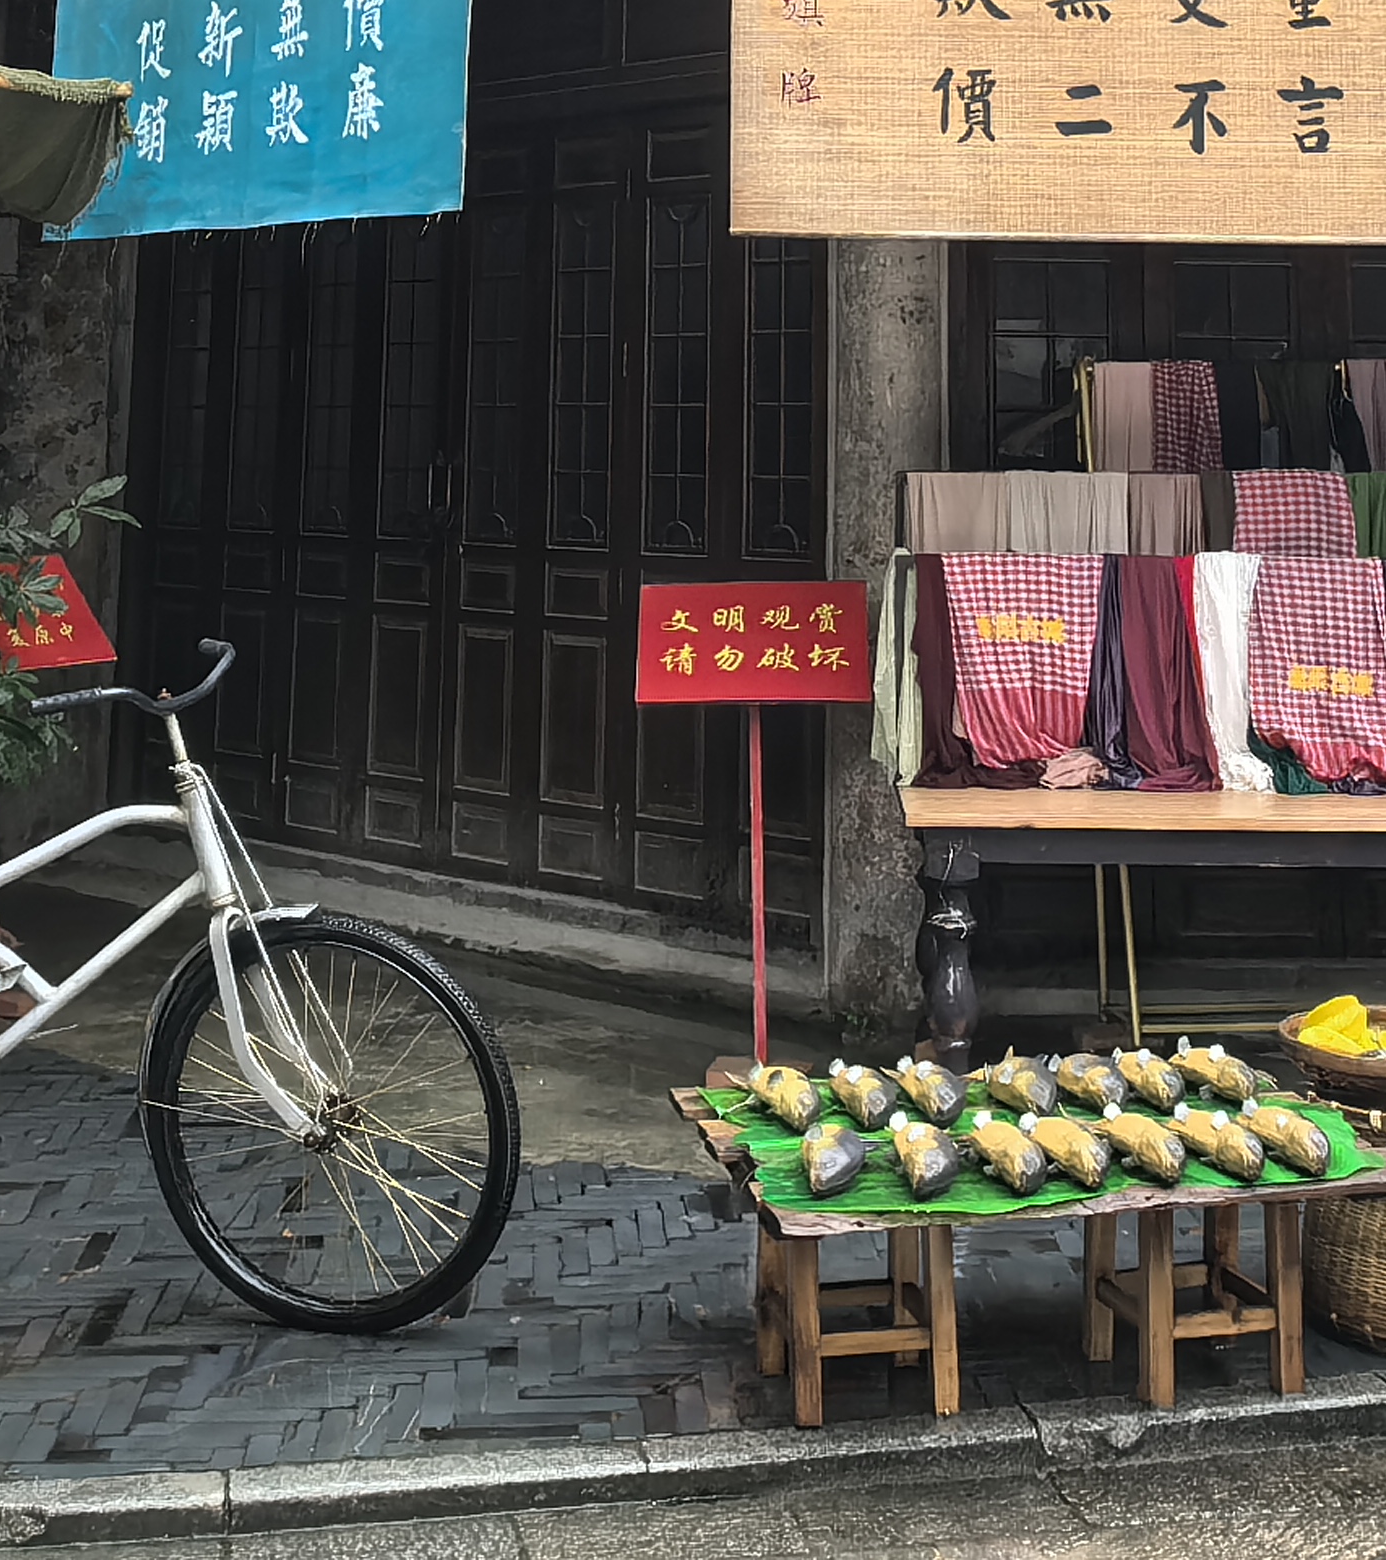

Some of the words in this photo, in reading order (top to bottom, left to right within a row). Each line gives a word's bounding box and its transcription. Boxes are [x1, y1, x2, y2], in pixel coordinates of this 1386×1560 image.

[660, 602, 843, 634] 文明观赏
[658, 642, 850, 676] 请勿破坏
